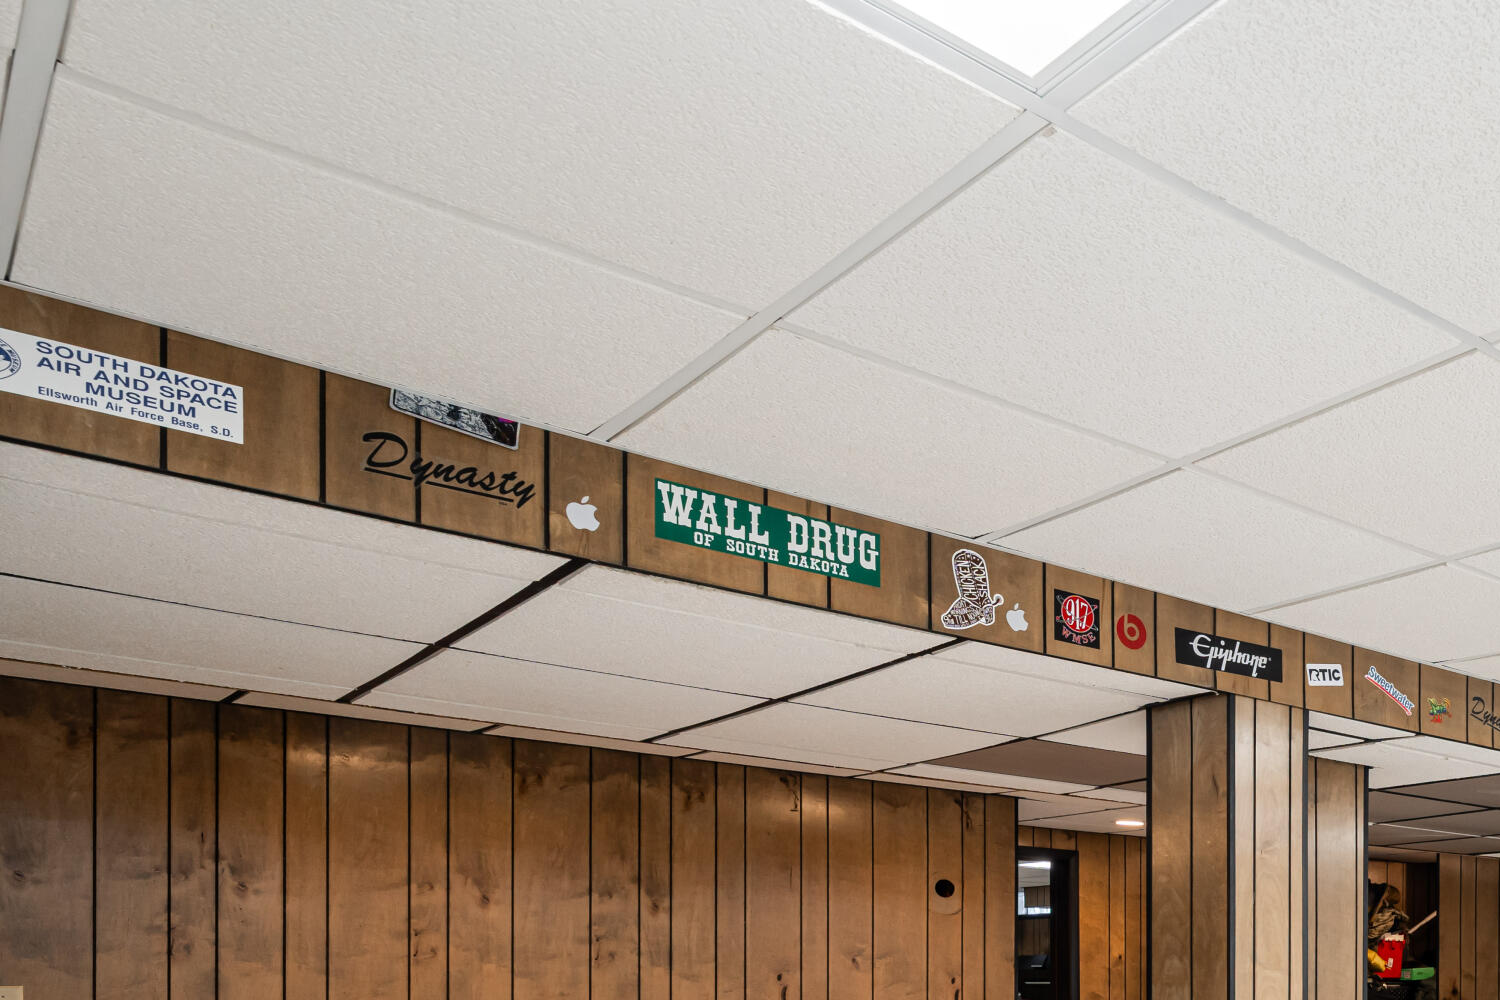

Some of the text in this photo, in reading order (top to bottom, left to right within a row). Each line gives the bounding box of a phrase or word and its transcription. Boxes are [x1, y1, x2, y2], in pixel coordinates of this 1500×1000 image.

[36, 340, 237, 400] SOUTH DAKOTA
[37, 356, 238, 414] AIR AND SPACE
[37, 386, 234, 438] Ellsworth Air Force Base, S.D.
[85, 382, 196, 418] MUSEUM
[362, 431, 536, 509] Dynasty
[657, 480, 879, 571] WALL DRUG
[693, 531, 850, 578] OF SOUTH DAKOTA
[956, 560, 979, 600] CHICKEN
[970, 560, 988, 599] SHACK
[1062, 626, 1096, 644] WMSE
[1189, 634, 1268, 678] Epiphone
[1308, 668, 1341, 681] RTIC
[1368, 665, 1415, 711] Sweetwater
